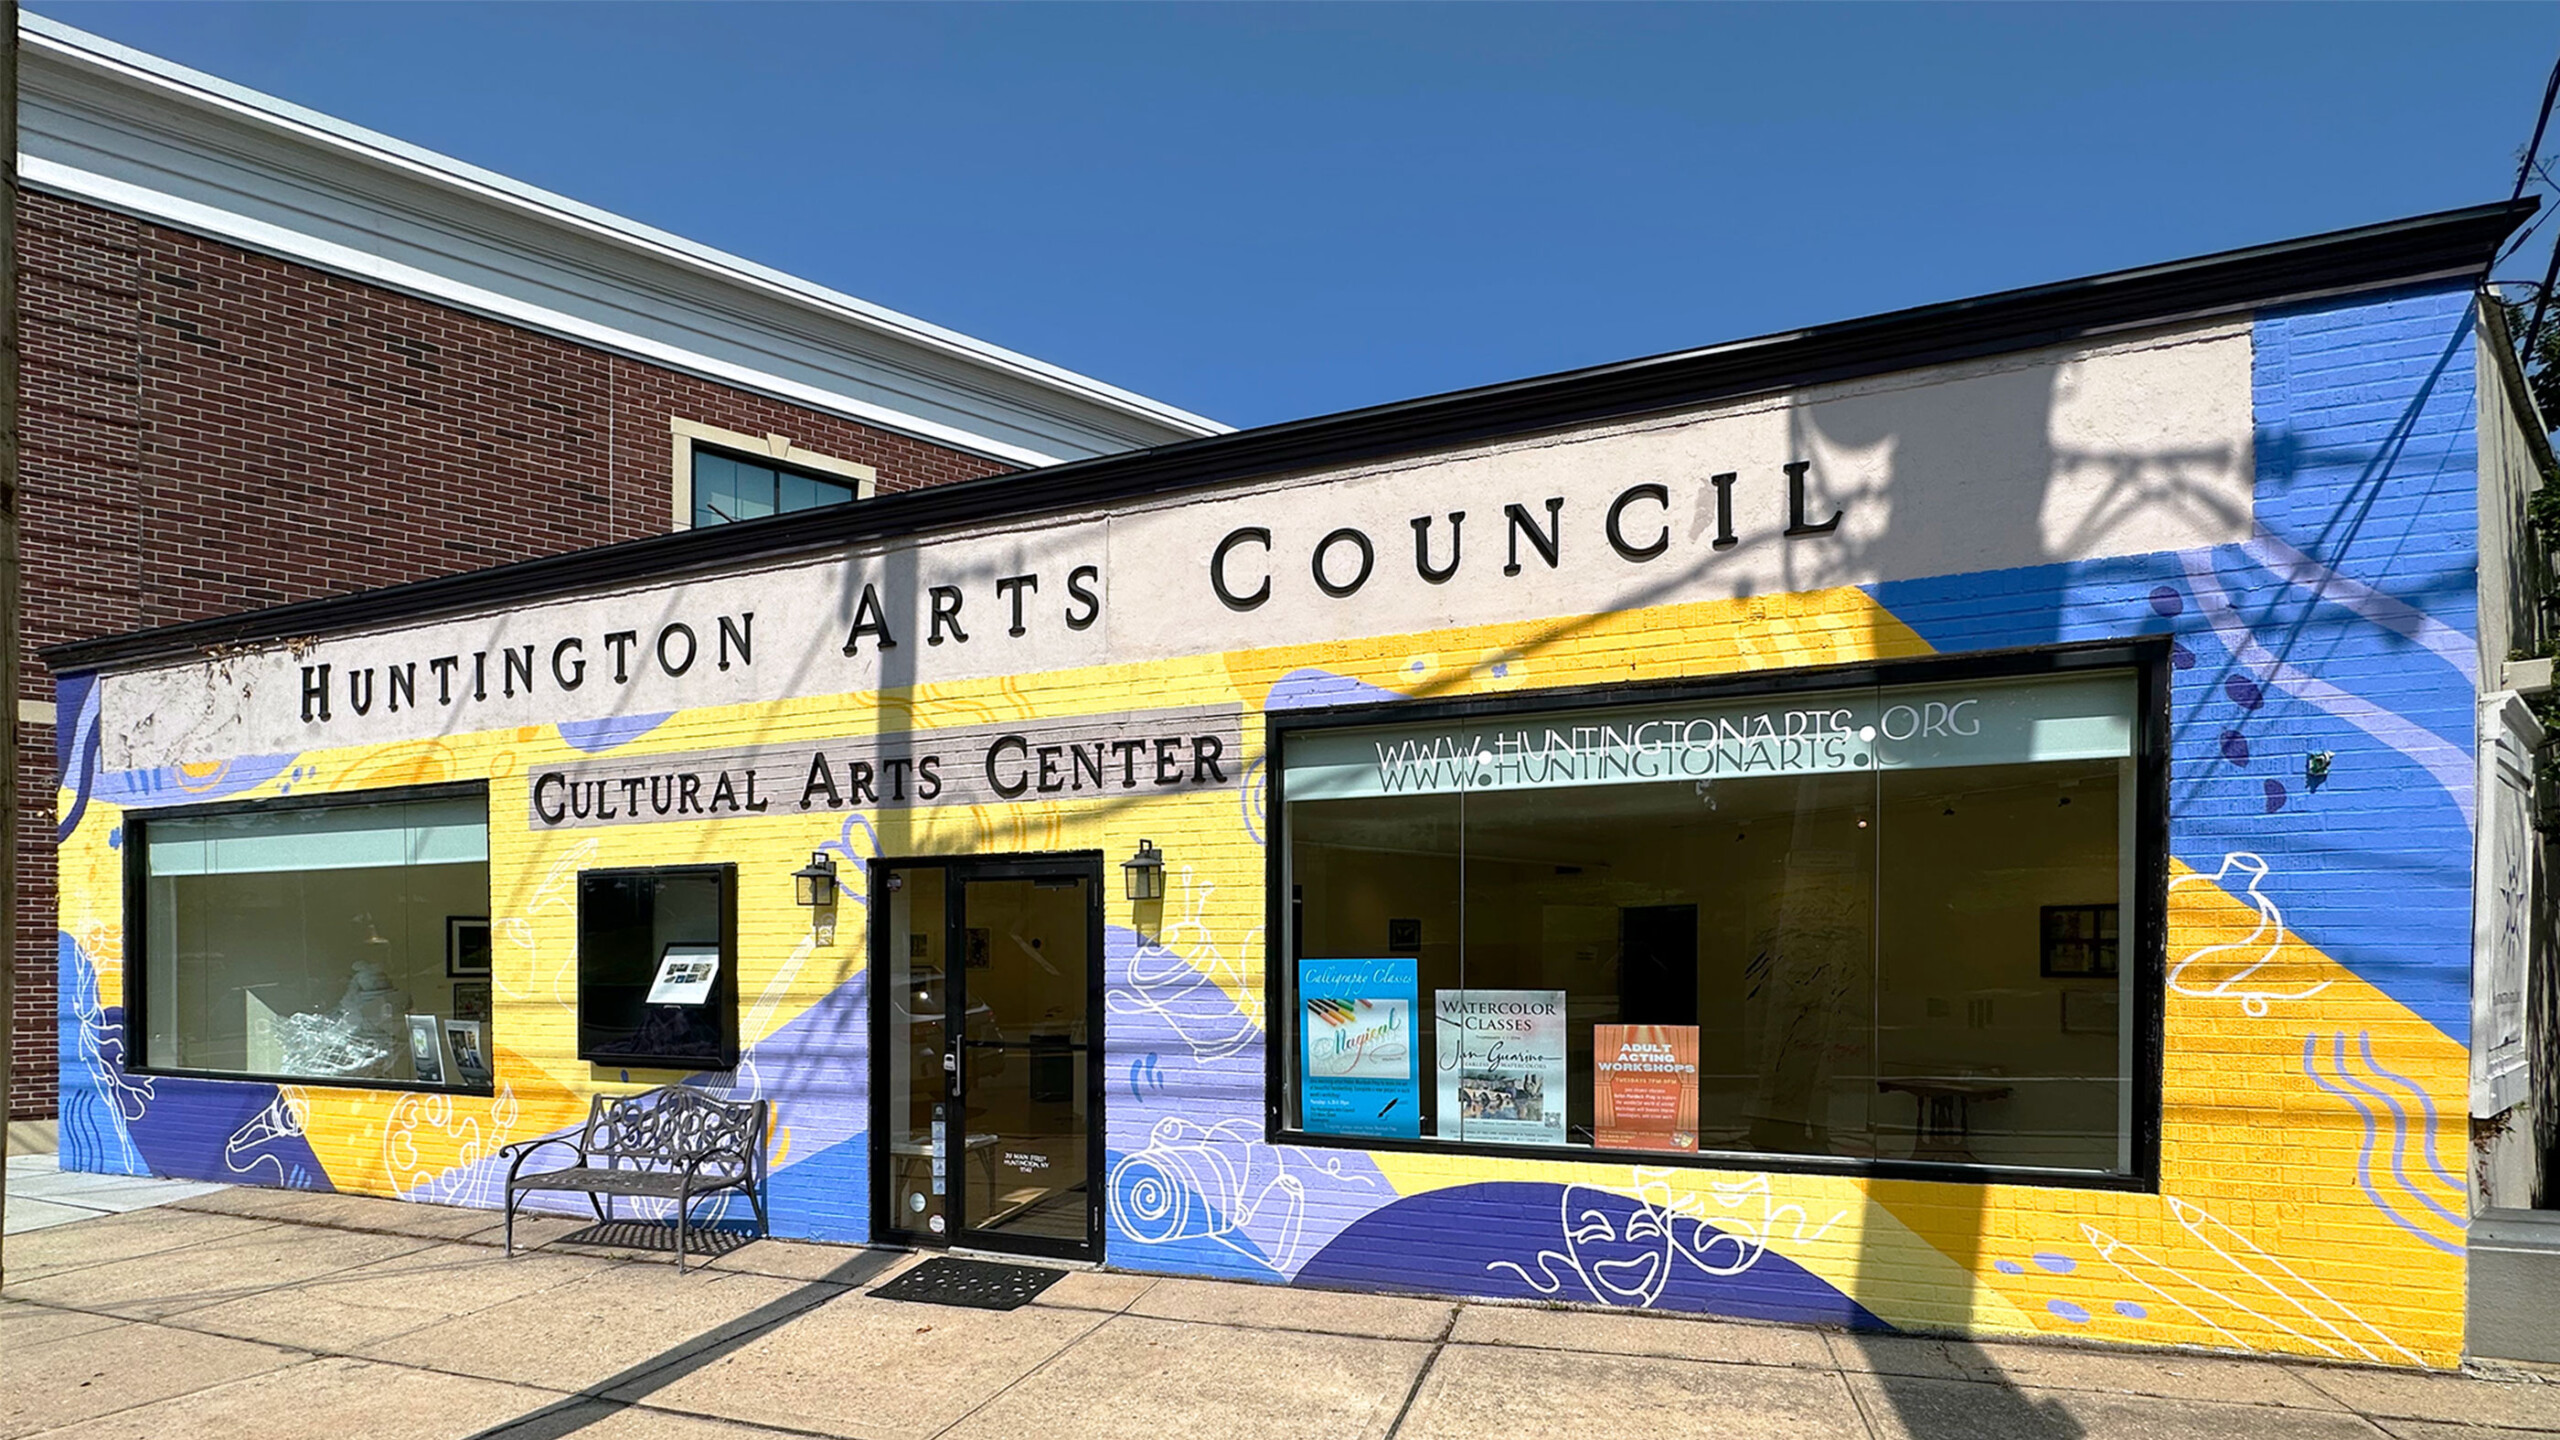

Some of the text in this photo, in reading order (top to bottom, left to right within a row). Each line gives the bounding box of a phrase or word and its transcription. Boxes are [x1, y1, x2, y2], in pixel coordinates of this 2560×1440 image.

[300, 460, 1843, 723] HUNTINGTON ARTS COUNCIL
[1375, 699, 1981, 772] WWW.HUNTINGTONARTS.ORG
[533, 735, 1228, 825] CULTURAL ARTS CENTER
[1305, 960, 1412, 998] Calligraphy Classes
[1441, 1000, 1557, 1016] WATERCOLOR
[1464, 1016, 1533, 1032] CLASSES
[1334, 1007, 1401, 1072] Magical
[1620, 1043, 1672, 1053] ADULT
[1598, 1062, 1696, 1074] WORKSHOPS
[1617, 1052, 1676, 1063] ACTING
